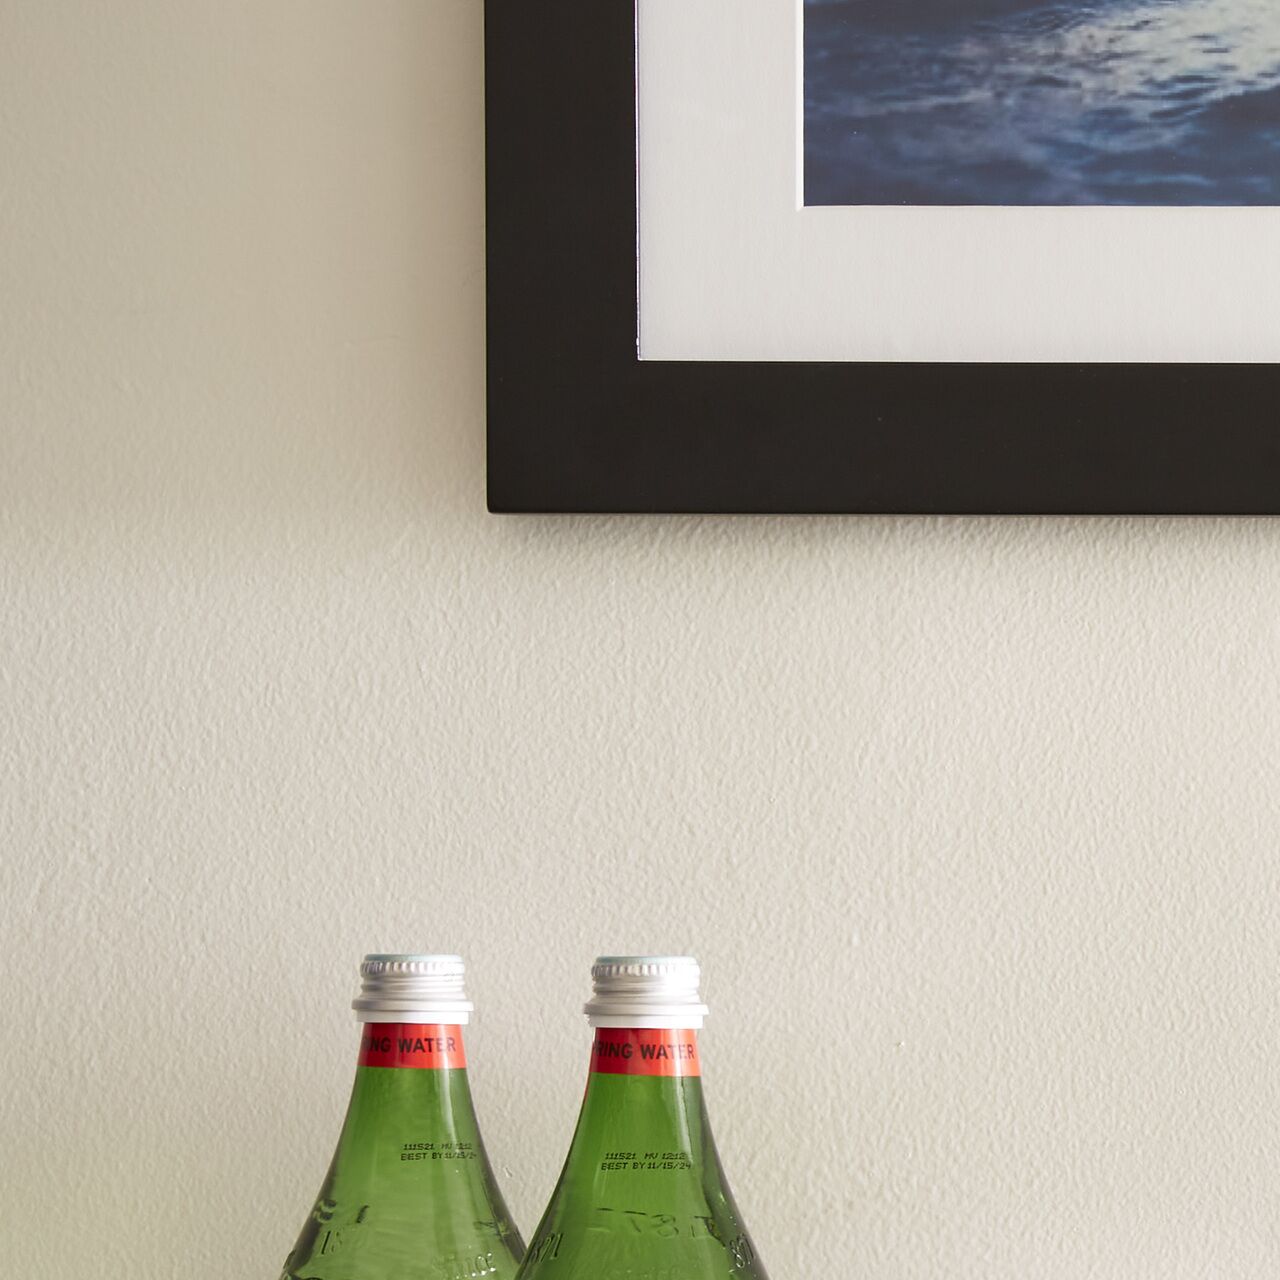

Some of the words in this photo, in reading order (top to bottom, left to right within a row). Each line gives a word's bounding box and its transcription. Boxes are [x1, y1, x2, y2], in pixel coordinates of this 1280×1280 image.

[398, 1038, 456, 1052] WATER
[640, 1043, 695, 1060] WATER
[601, 1162, 628, 1170] BEST
